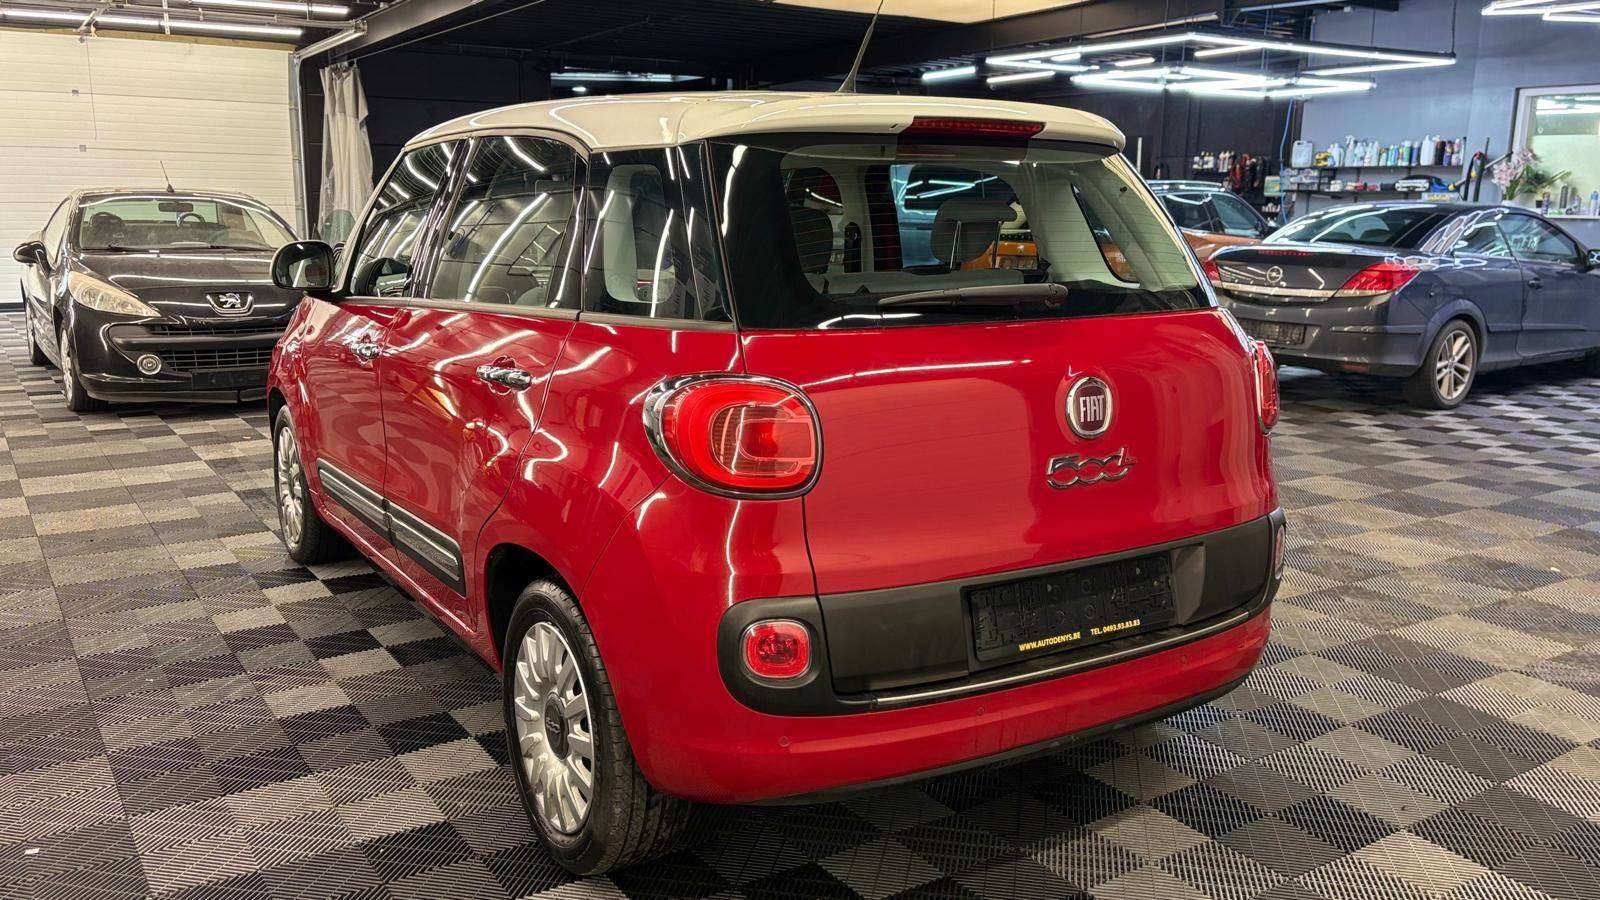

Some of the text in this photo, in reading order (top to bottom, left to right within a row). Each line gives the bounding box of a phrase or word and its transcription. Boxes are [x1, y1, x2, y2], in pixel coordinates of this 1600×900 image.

[1080, 395, 1105, 422] FIAT
[1019, 618, 1141, 652] WWW.AUTODENYS.BE TEL. 0493.93.83.83
